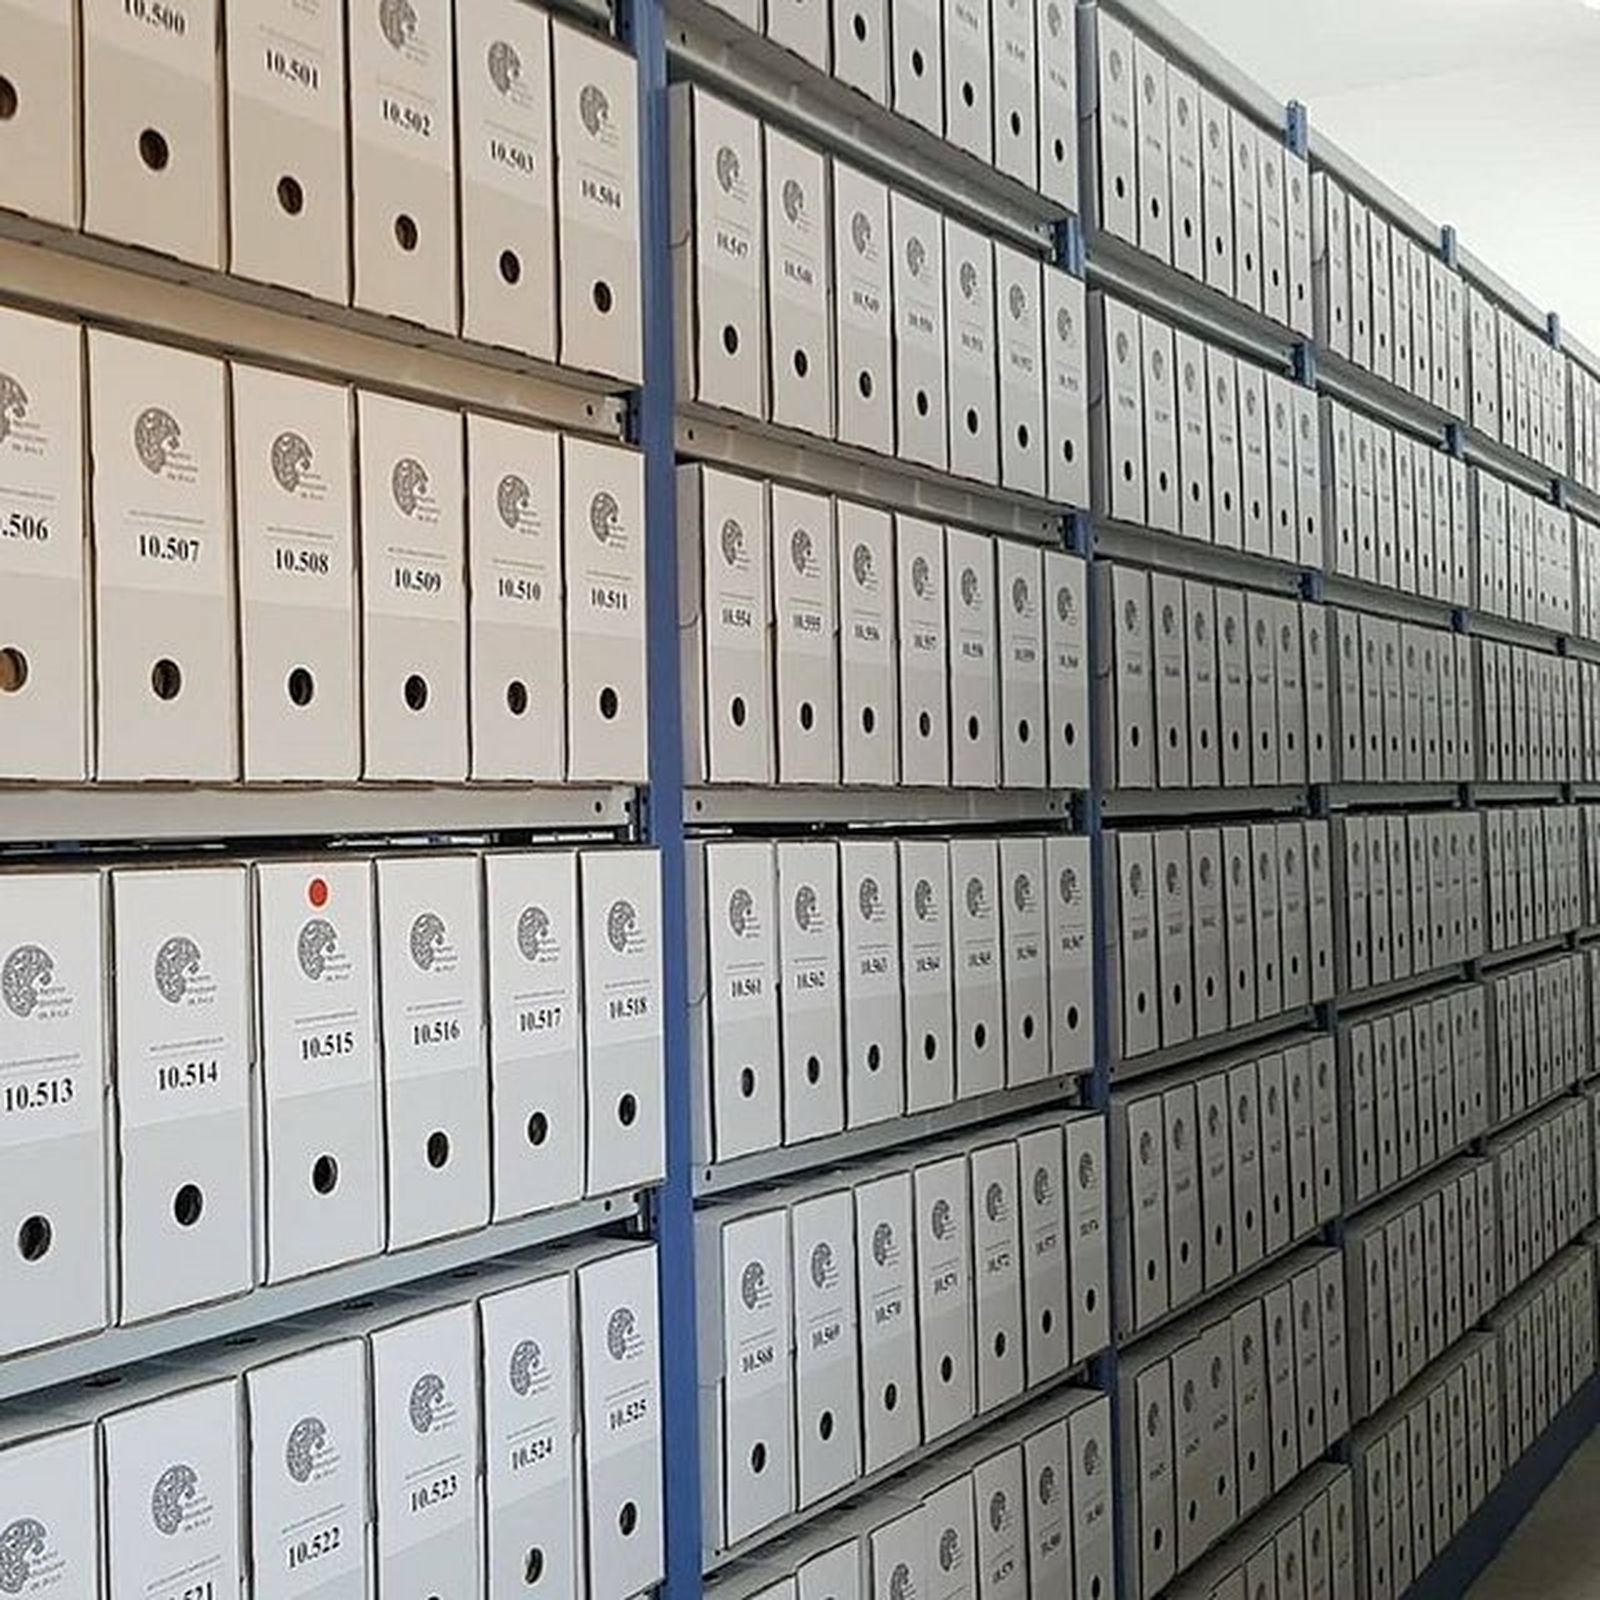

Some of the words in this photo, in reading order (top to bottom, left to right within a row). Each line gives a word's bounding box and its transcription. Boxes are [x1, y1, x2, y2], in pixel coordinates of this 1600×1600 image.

[124, 0, 185, 35] 10.500
[265, 49, 319, 89] 10.501
[383, 99, 430, 136] 10.502
[490, 140, 535, 172] 10.503
[581, 179, 621, 209] 10.504
[0, 513, 49, 541] .506
[139, 534, 199, 562] 10.507
[275, 549, 329, 575] 10.508
[394, 568, 441, 593] 10.509
[498, 578, 541, 600] 10.510
[591, 588, 627, 610] 10.511
[520, 1008, 561, 1032] 10.517
[609, 997, 647, 1018] 10.518
[301, 1032, 354, 1060] 10.515
[413, 1020, 460, 1045] 10.516
[157, 1061, 218, 1090] 10.514
[4, 1078, 74, 1111] 10.513
[610, 1399, 646, 1430] 10.525
[512, 1438, 553, 1470] 10.524
[411, 1475, 457, 1511] 10.523
[288, 1526, 341, 1568] 10.522
